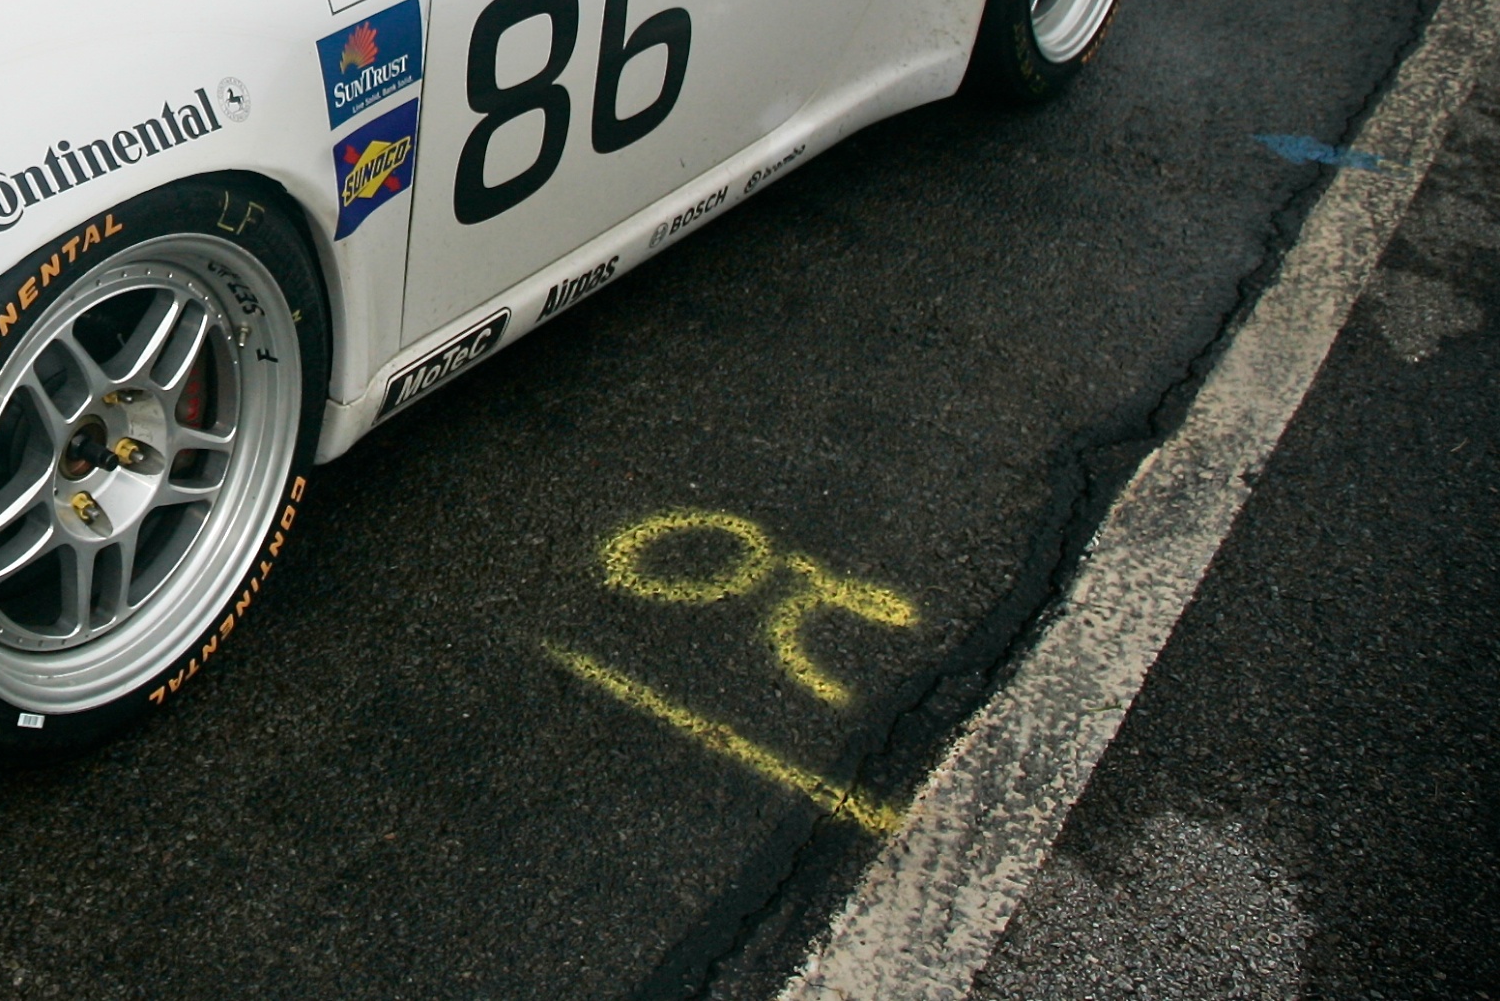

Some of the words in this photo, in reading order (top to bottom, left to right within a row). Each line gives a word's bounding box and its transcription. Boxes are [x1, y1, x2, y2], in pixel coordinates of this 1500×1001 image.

[345, 140, 409, 203] SUNOCO
[669, 185, 729, 236] BOSCH
[536, 255, 620, 324] Airgas
[394, 327, 493, 406] MoTeC
[148, 475, 307, 706] CONTINENTAL
